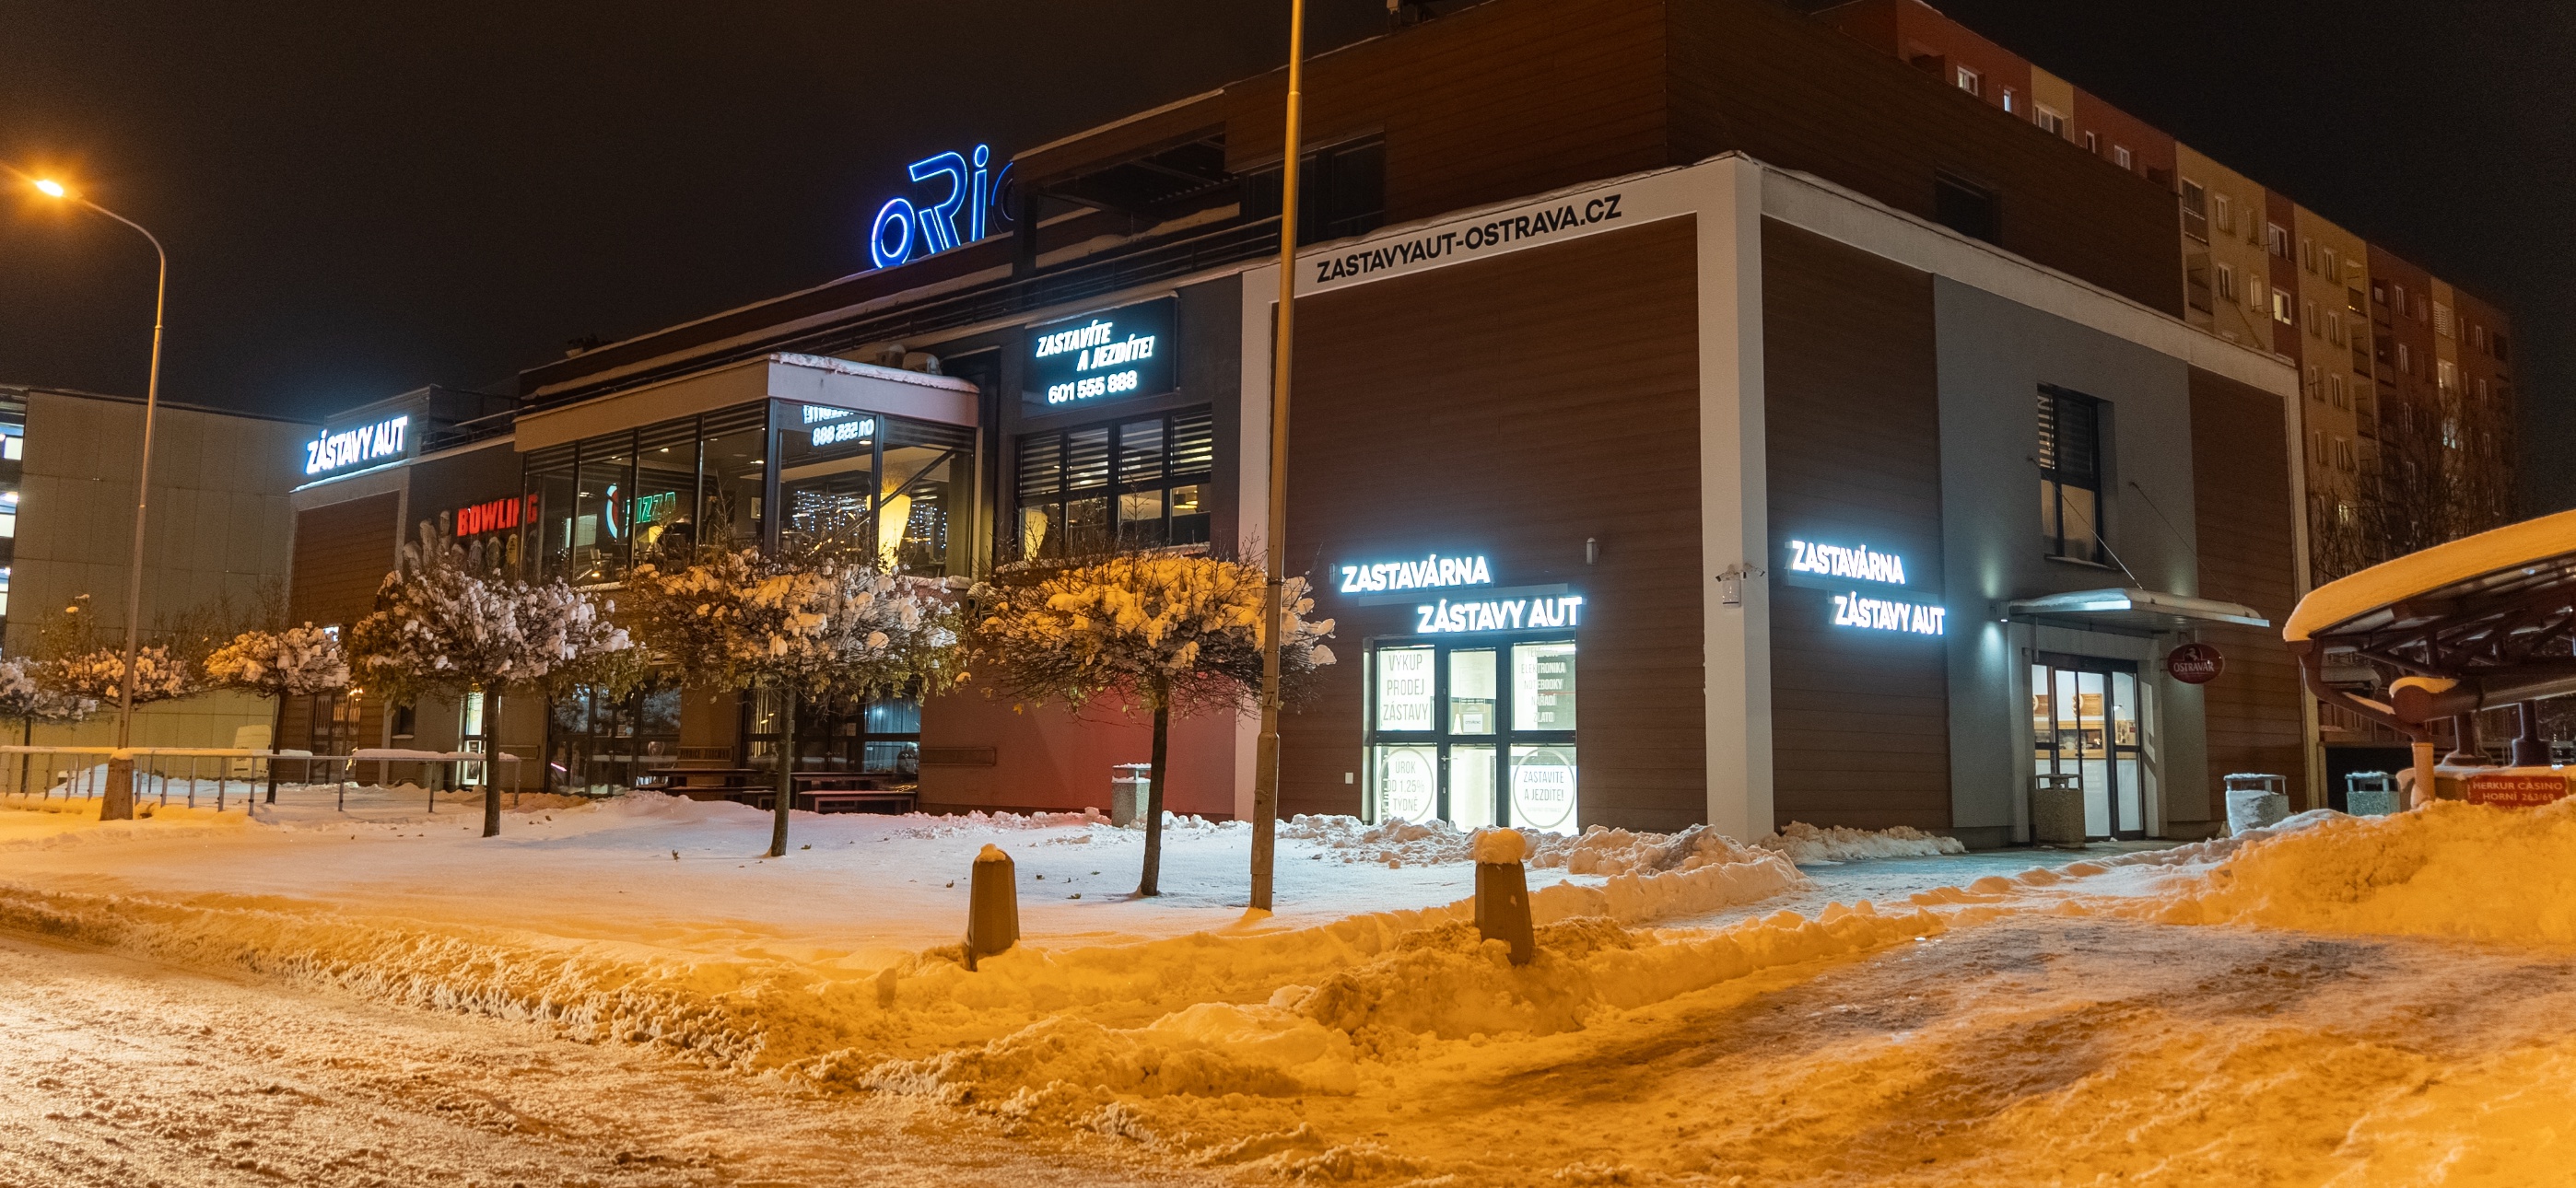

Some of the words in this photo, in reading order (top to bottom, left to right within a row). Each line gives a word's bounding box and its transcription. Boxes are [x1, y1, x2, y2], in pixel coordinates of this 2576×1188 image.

[1317, 193, 1622, 284] ZASTAVYAUT-OSTRAVA.CZ
[1036, 319, 1113, 357] ZASTAVÍTE
[1076, 350, 1089, 371] A
[1090, 333, 1155, 369] JEZDÍTE!
[1048, 381, 1075, 404] 601
[1076, 376, 1106, 399] 555
[1107, 370, 1138, 393] 888
[306, 429, 374, 474] ZÁSTAVY
[371, 415, 408, 458] AUT
[1341, 553, 1492, 593] ZASTAVÁRNA
[1792, 540, 1906, 585] ZASTAVÁRNA
[1417, 599, 1526, 634] ZÁSTAVY
[1528, 596, 1583, 628] AUT
[1834, 590, 1912, 632] ZÁSTAVY
[1911, 604, 1946, 635] AUT
[1388, 651, 1423, 670] VÝKUP
[2173, 661, 2215, 672] OSTRAVAR
[1387, 679, 1424, 696] PRODEJ
[1383, 700, 1429, 721] ZÁSTAVY
[1524, 788, 1529, 800] A
[2473, 781, 2515, 790] MERKUR
[2517, 781, 2563, 790] CASINO
